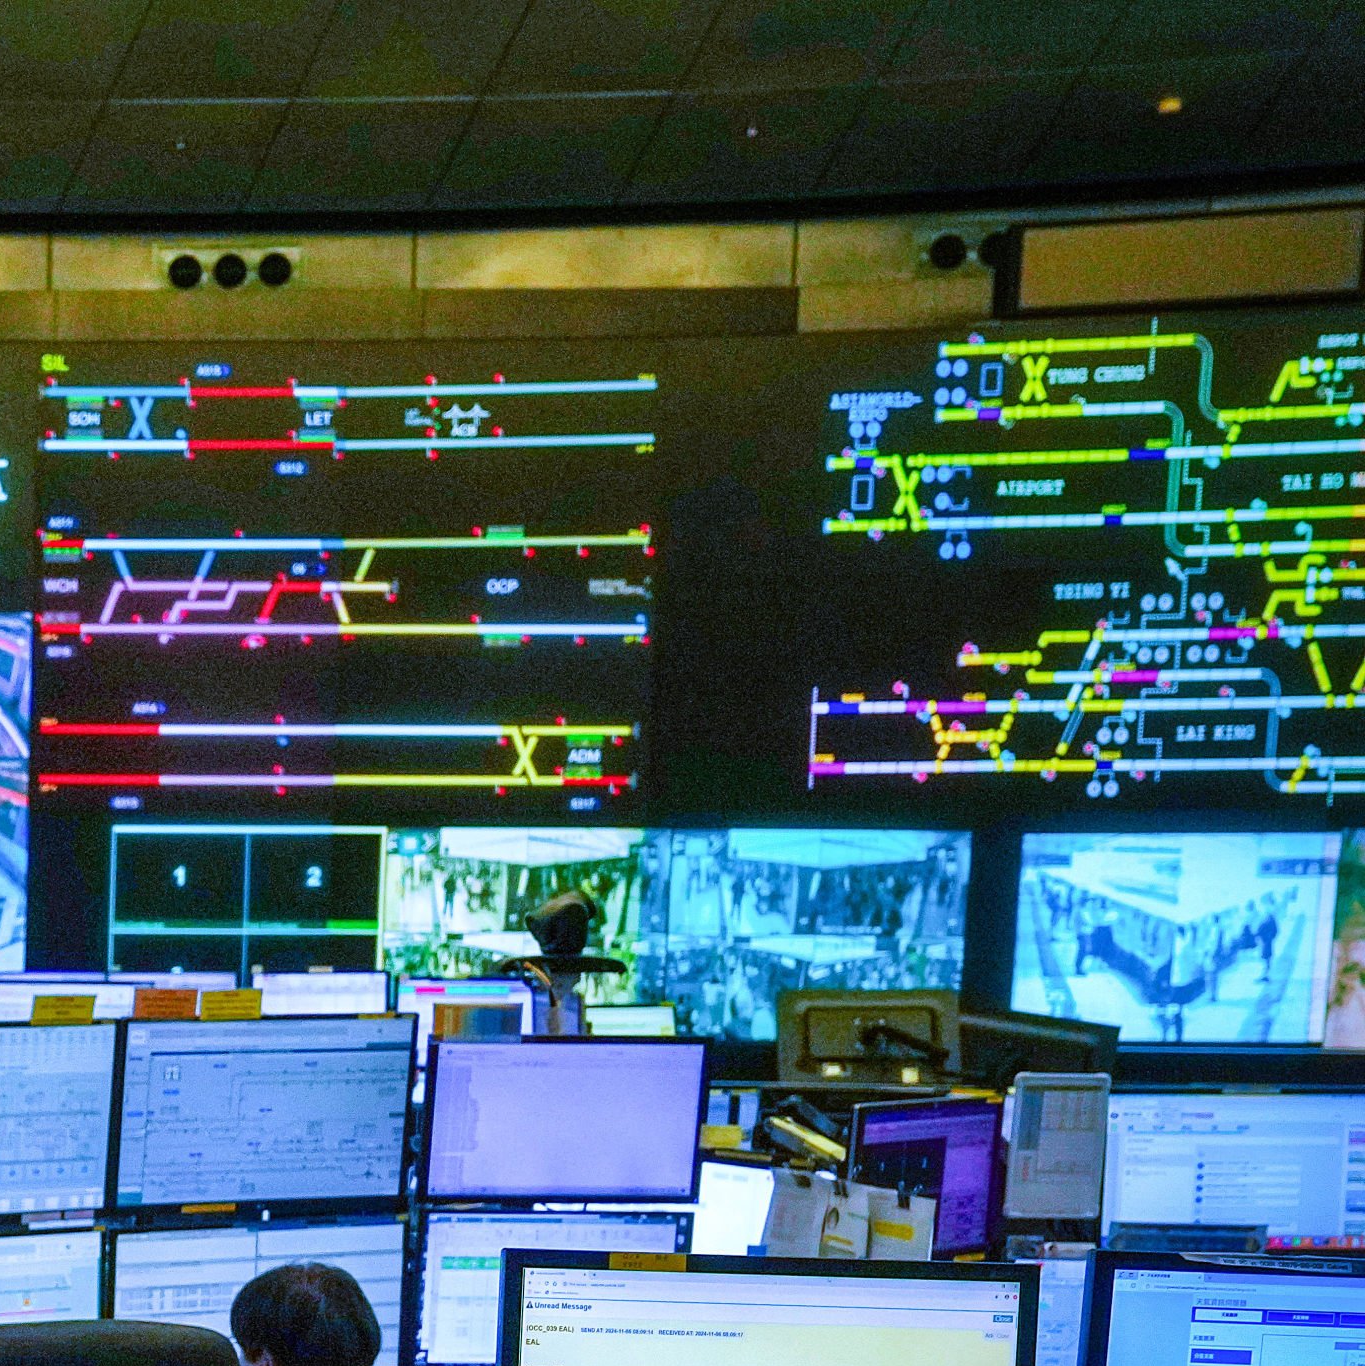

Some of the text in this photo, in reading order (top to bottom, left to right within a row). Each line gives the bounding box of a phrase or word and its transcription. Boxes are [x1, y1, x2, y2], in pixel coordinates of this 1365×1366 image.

[41, 354, 69, 372] SIL
[1047, 364, 1145, 385] TUNG CHUNG
[69, 411, 100, 426] SOH
[305, 411, 331, 426] LET
[997, 479, 1065, 497] AIRPORT
[1281, 472, 1344, 492] TAI HO
[43, 579, 78, 594] WCH
[487, 578, 519, 594] OCP
[1054, 581, 1130, 600] TSING YI
[1177, 723, 1256, 742] LAI KING
[568, 748, 600, 764] ADM
[172, 865, 187, 887] 1
[306, 865, 323, 888] 2
[534, 1302, 592, 1311] Unread Message
[559, 1325, 574, 1334] EAL)
[526, 1338, 540, 1346] EAL
